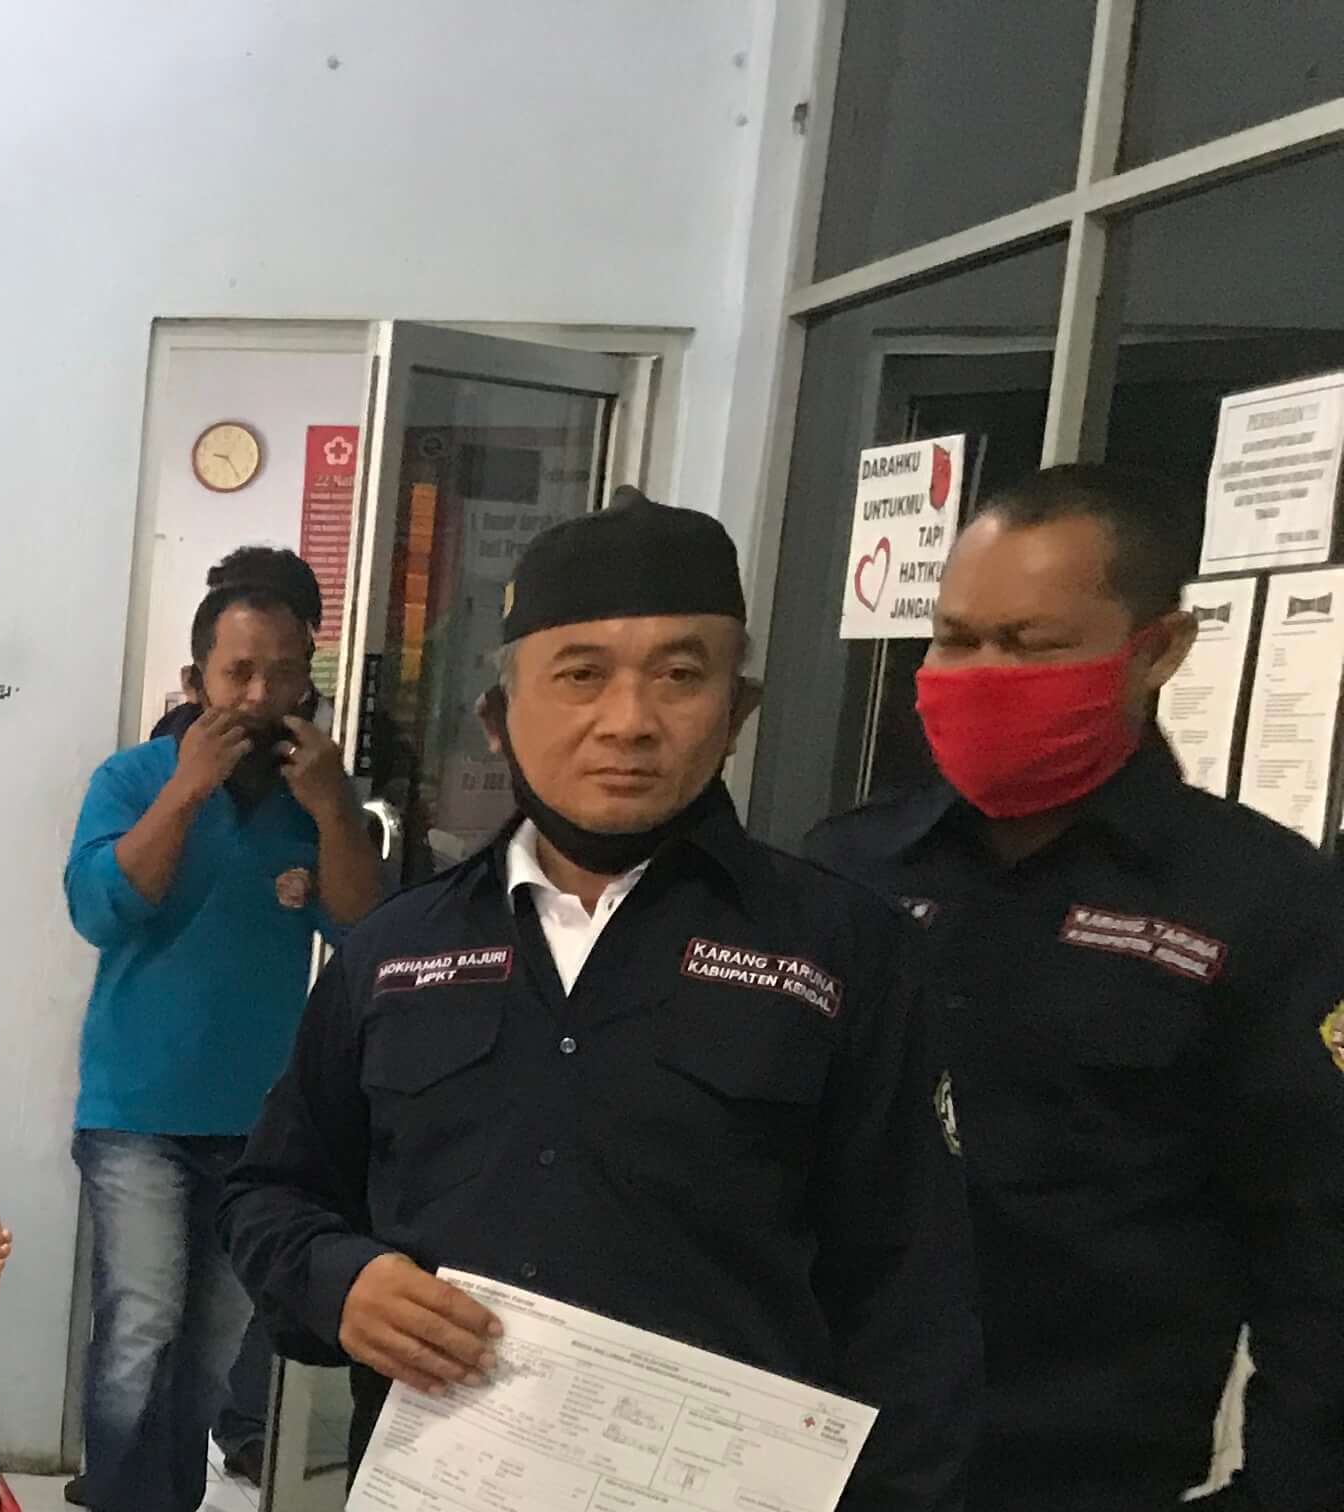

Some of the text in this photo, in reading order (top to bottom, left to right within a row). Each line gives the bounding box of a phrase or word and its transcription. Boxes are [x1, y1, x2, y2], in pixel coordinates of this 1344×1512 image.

[862, 451, 921, 481] DARAHKU
[863, 493, 924, 521] UNTUKMU
[918, 525, 944, 548] TAPI
[378, 950, 508, 979] MOKHAMAD BAJURI
[415, 969, 457, 986] MPKT
[693, 942, 836, 995] KARANG TARUNA
[687, 959, 832, 1012] KABUPATEN KENDAL
